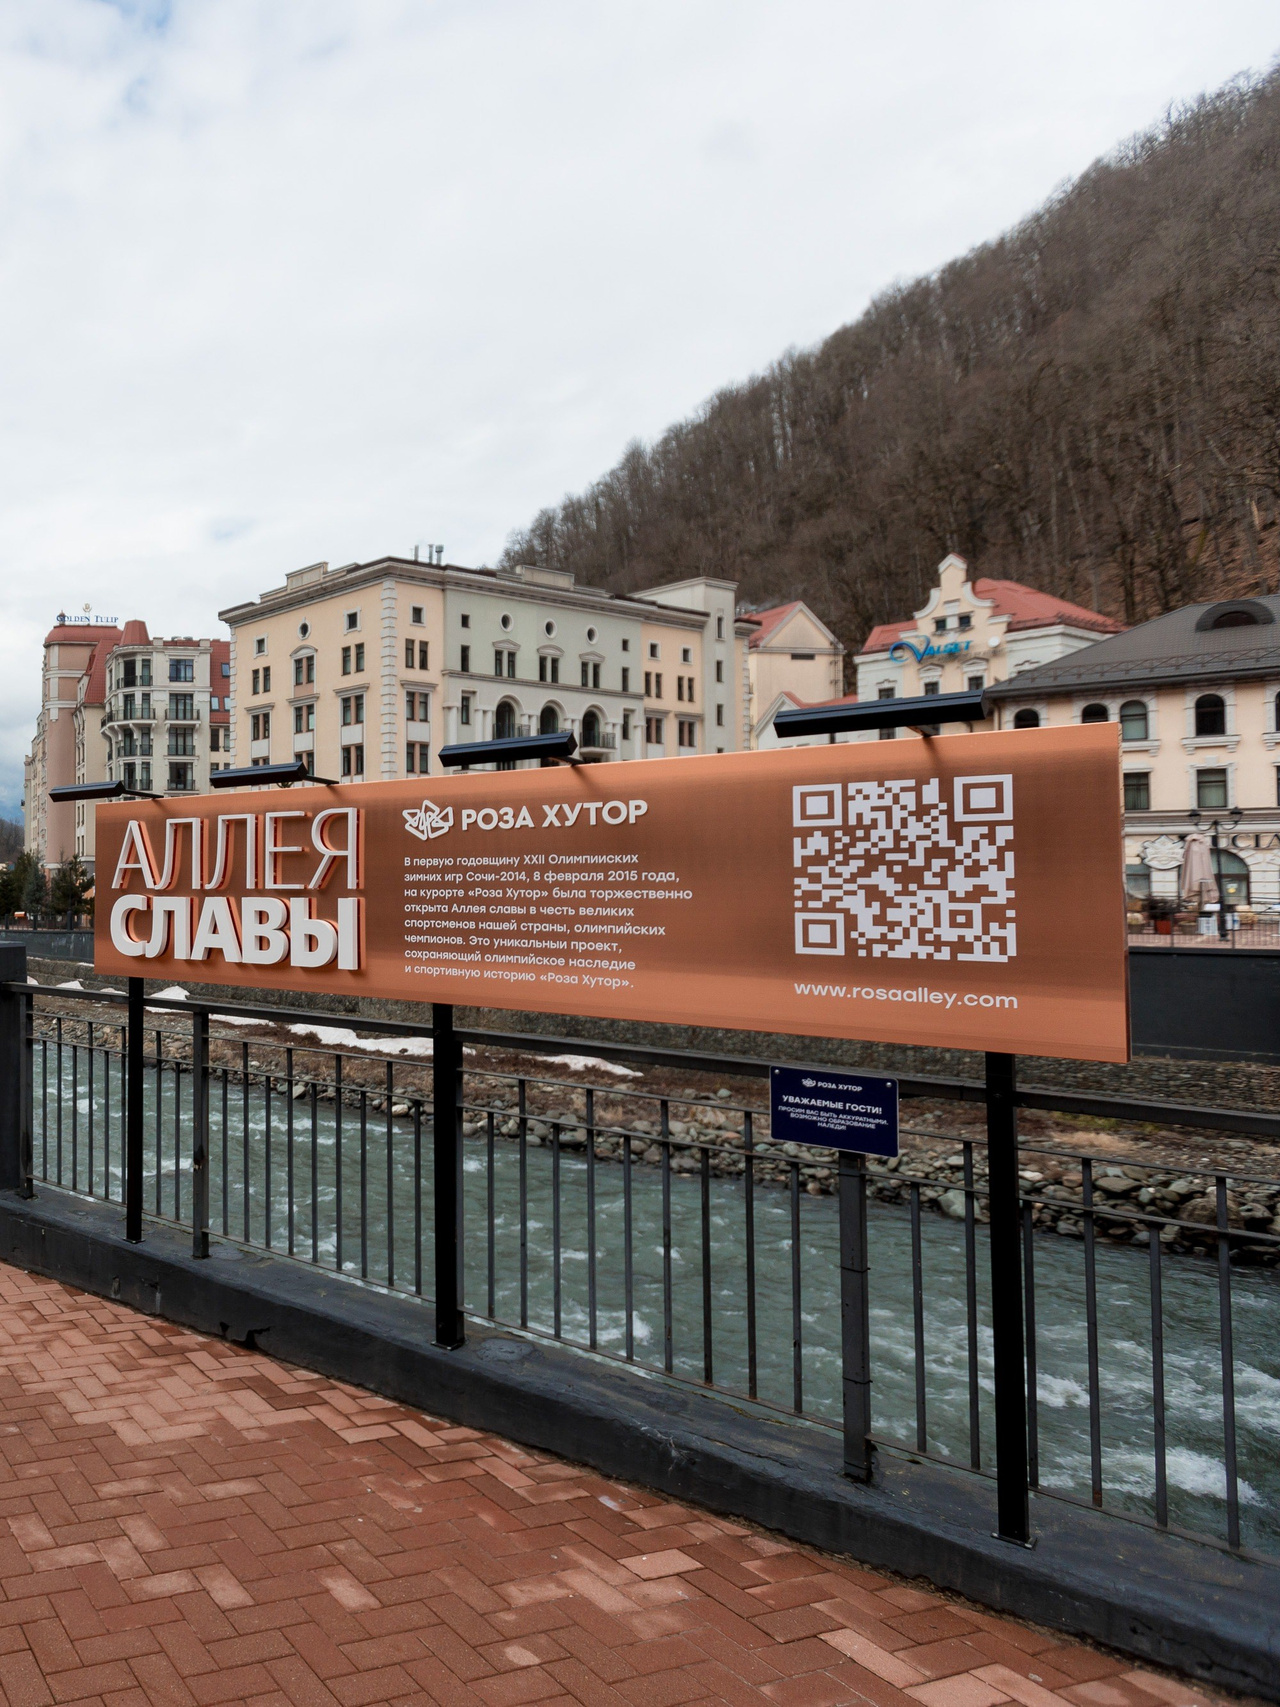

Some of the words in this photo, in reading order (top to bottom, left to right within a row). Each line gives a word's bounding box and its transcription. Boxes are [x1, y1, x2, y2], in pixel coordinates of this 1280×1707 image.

[94, 615, 118, 623] TULIP
[462, 806, 534, 830] РОЗА
[542, 800, 647, 827] ХУТОР
[111, 807, 357, 890] АЛЛЕЯ
[404, 856, 411, 867] В
[413, 857, 454, 869] первую
[456, 856, 521, 868] годовщину
[523, 854, 545, 865] XXII
[404, 873, 442, 882] зимних
[444, 873, 464, 884] игр
[465, 871, 530, 883] Сочи-2014,
[533, 871, 541, 882] 8
[543, 870, 604, 884] февраля
[607, 870, 638, 881] 2015
[641, 871, 680, 883] года,
[404, 888, 418, 897] на
[419, 888, 465, 900] курорте
[467, 887, 503, 898] «Роза
[505, 887, 549, 901] Хутор»
[552, 886, 587, 899] была
[589, 889, 693, 902] торжественно
[404, 904, 449, 915] открыта
[451, 903, 487, 914] Аллея
[489, 905, 527, 915] славы
[529, 906, 537, 915] в
[539, 906, 576, 916] честь
[578, 906, 635, 917] великих
[110, 894, 358, 970] СЛАВЫ
[404, 919, 476, 931] спортсменов
[478, 919, 517, 931] нашей
[520, 922, 571, 934] страны,
[574, 922, 666, 936] олимпийских
[404, 934, 466, 945] чемпионов.
[468, 935, 491, 946] Это
[570, 941, 622, 954] проект,
[404, 949, 482, 963] сохраняющий
[484, 953, 566, 967] олимпийское
[568, 958, 636, 971] наследие
[404, 965, 412, 973] и
[413, 965, 481, 980] спортивную
[483, 970, 537, 983] историю
[539, 972, 579, 984] «Роза
[582, 974, 634, 990] Хутор».
[794, 983, 1017, 1008] www.rosaalley.com
[782, 1095, 844, 1109] УВАЖАЕМЫЕ
[845, 1103, 882, 1114] ГОСТИ!
